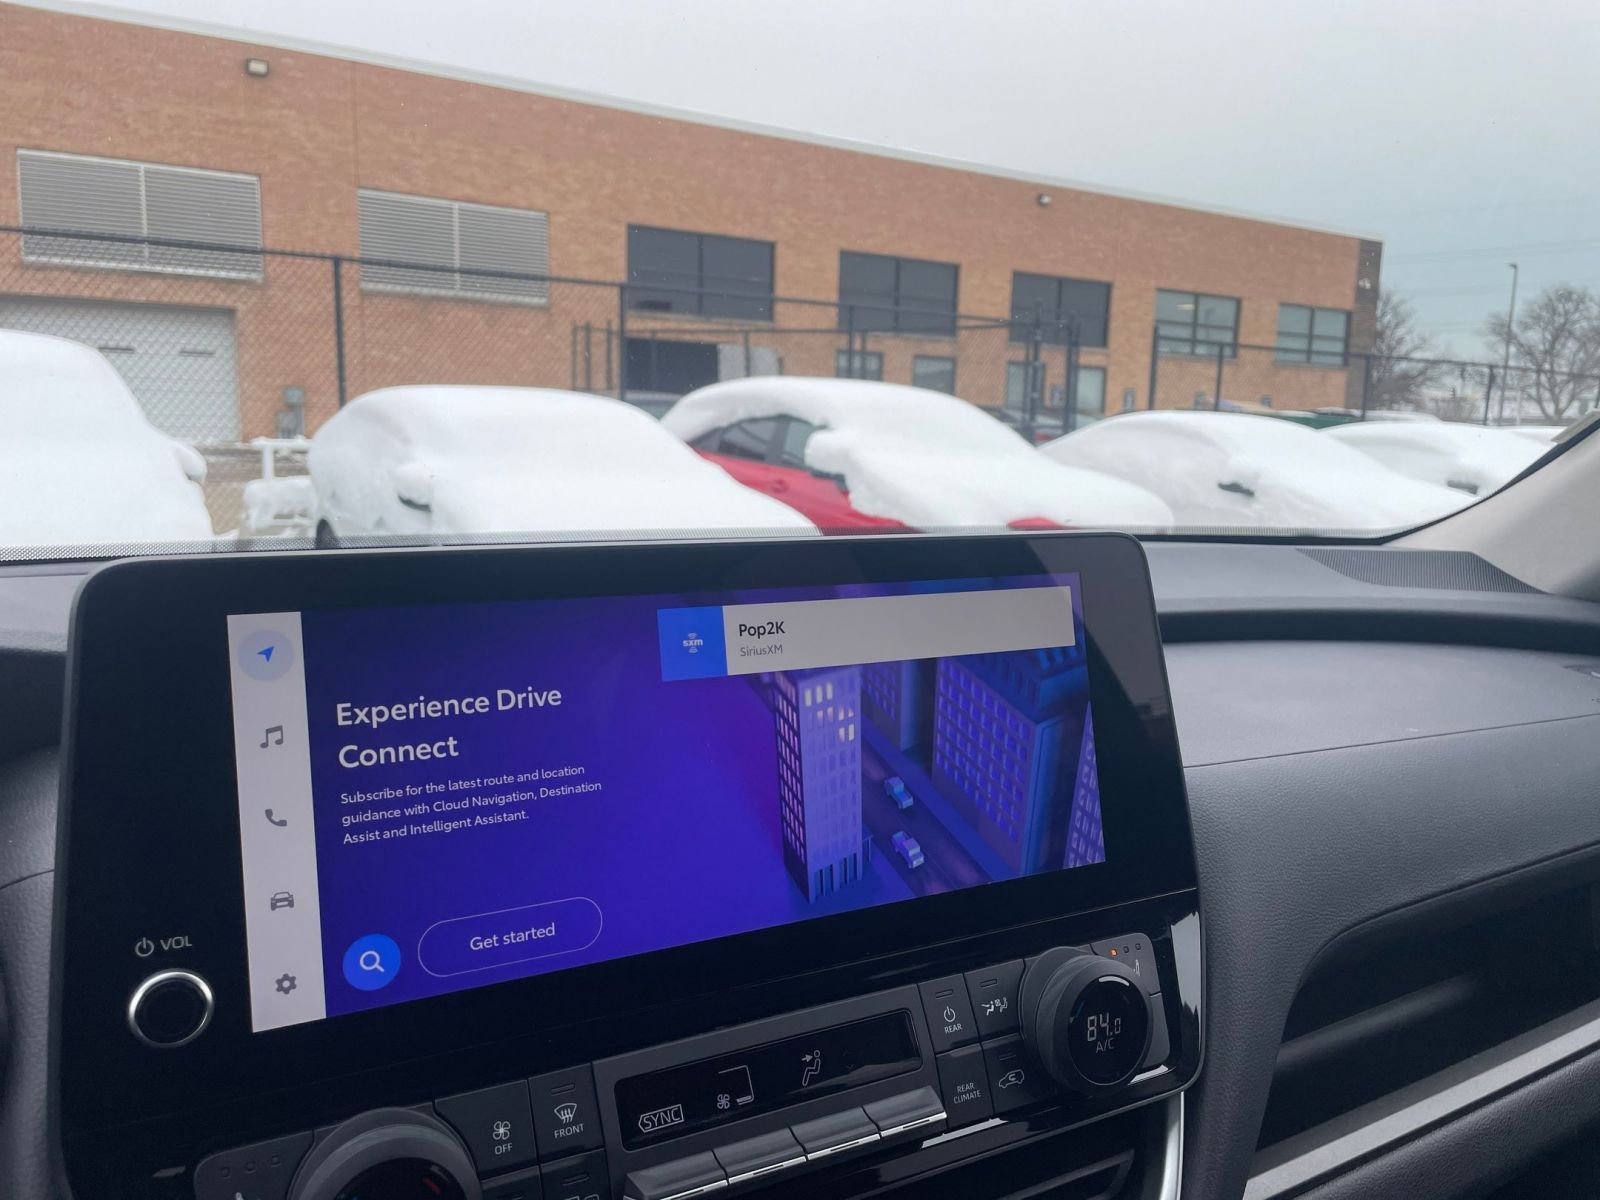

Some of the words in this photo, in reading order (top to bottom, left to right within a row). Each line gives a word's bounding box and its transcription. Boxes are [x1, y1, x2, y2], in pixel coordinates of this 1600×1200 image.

[739, 621, 785, 638] Pop2K
[683, 638, 703, 647] sxm
[740, 644, 783, 657] SiriusXM
[336, 695, 489, 728] Experience
[497, 686, 562, 711] Drive
[339, 737, 458, 769] Connect
[341, 787, 403, 804] Subscribe
[406, 784, 422, 795] for
[426, 781, 445, 793] the
[448, 777, 482, 791] latest
[484, 774, 514, 786] route
[517, 770, 538, 782] and
[542, 764, 584, 780] location
[342, 807, 401, 826] guidance
[404, 802, 430, 815] with
[433, 797, 469, 813] Cloud
[472, 789, 537, 807] Navigation,
[540, 781, 602, 798] Destination
[343, 827, 380, 844] Assist
[383, 823, 407, 839] and
[410, 817, 471, 836] Intelligent
[475, 809, 529, 826] Assistant.
[160, 936, 193, 950] VOL
[470, 934, 498, 951] Get
[503, 922, 556, 944] started
[944, 1023, 962, 1034] REAR
[1087, 1012, 1121, 1042] 84.0
[1096, 1040, 1115, 1053] A/C
[957, 1082, 974, 1092] REAR
[954, 1090, 982, 1104] CLIMATE
[643, 1106, 681, 1130] SYNC
[554, 1123, 585, 1138] FRONT
[494, 1141, 513, 1155] OFF
